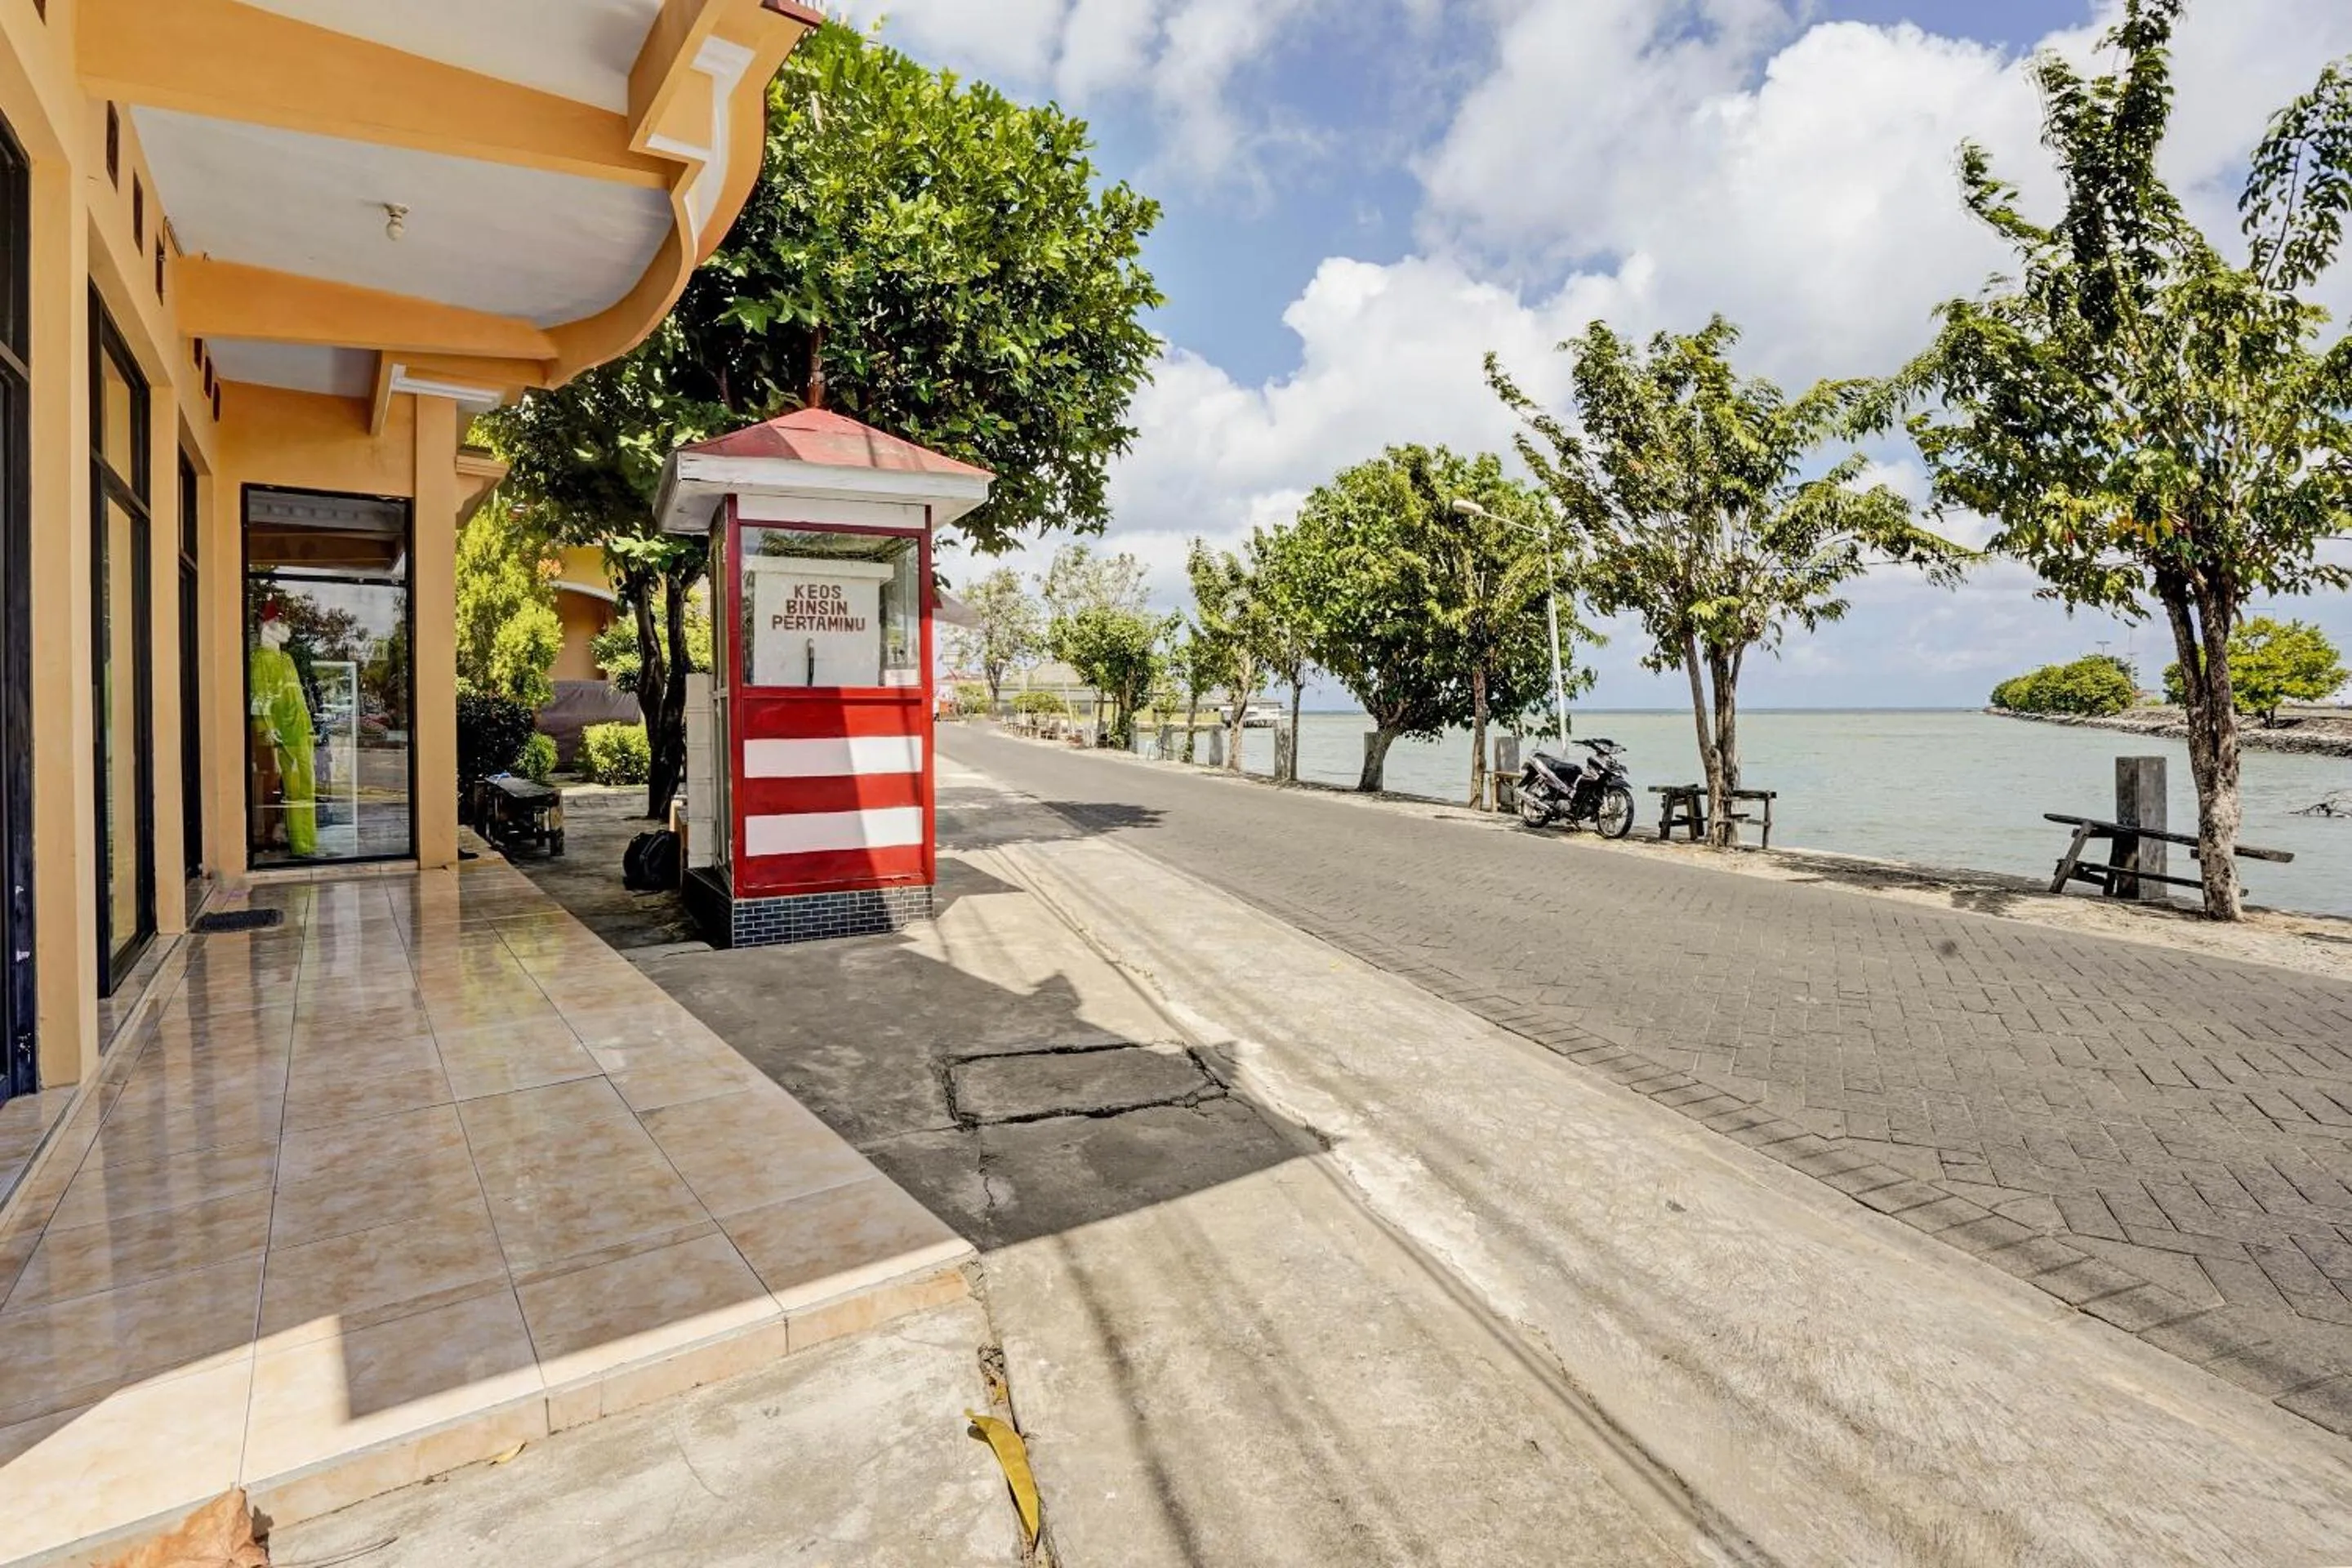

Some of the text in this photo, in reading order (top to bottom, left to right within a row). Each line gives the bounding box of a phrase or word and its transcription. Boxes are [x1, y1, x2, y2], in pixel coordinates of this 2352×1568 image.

[794, 584, 842, 599] KEOS
[786, 599, 848, 615] BINSIN
[772, 614, 866, 632] PERTAMINU
